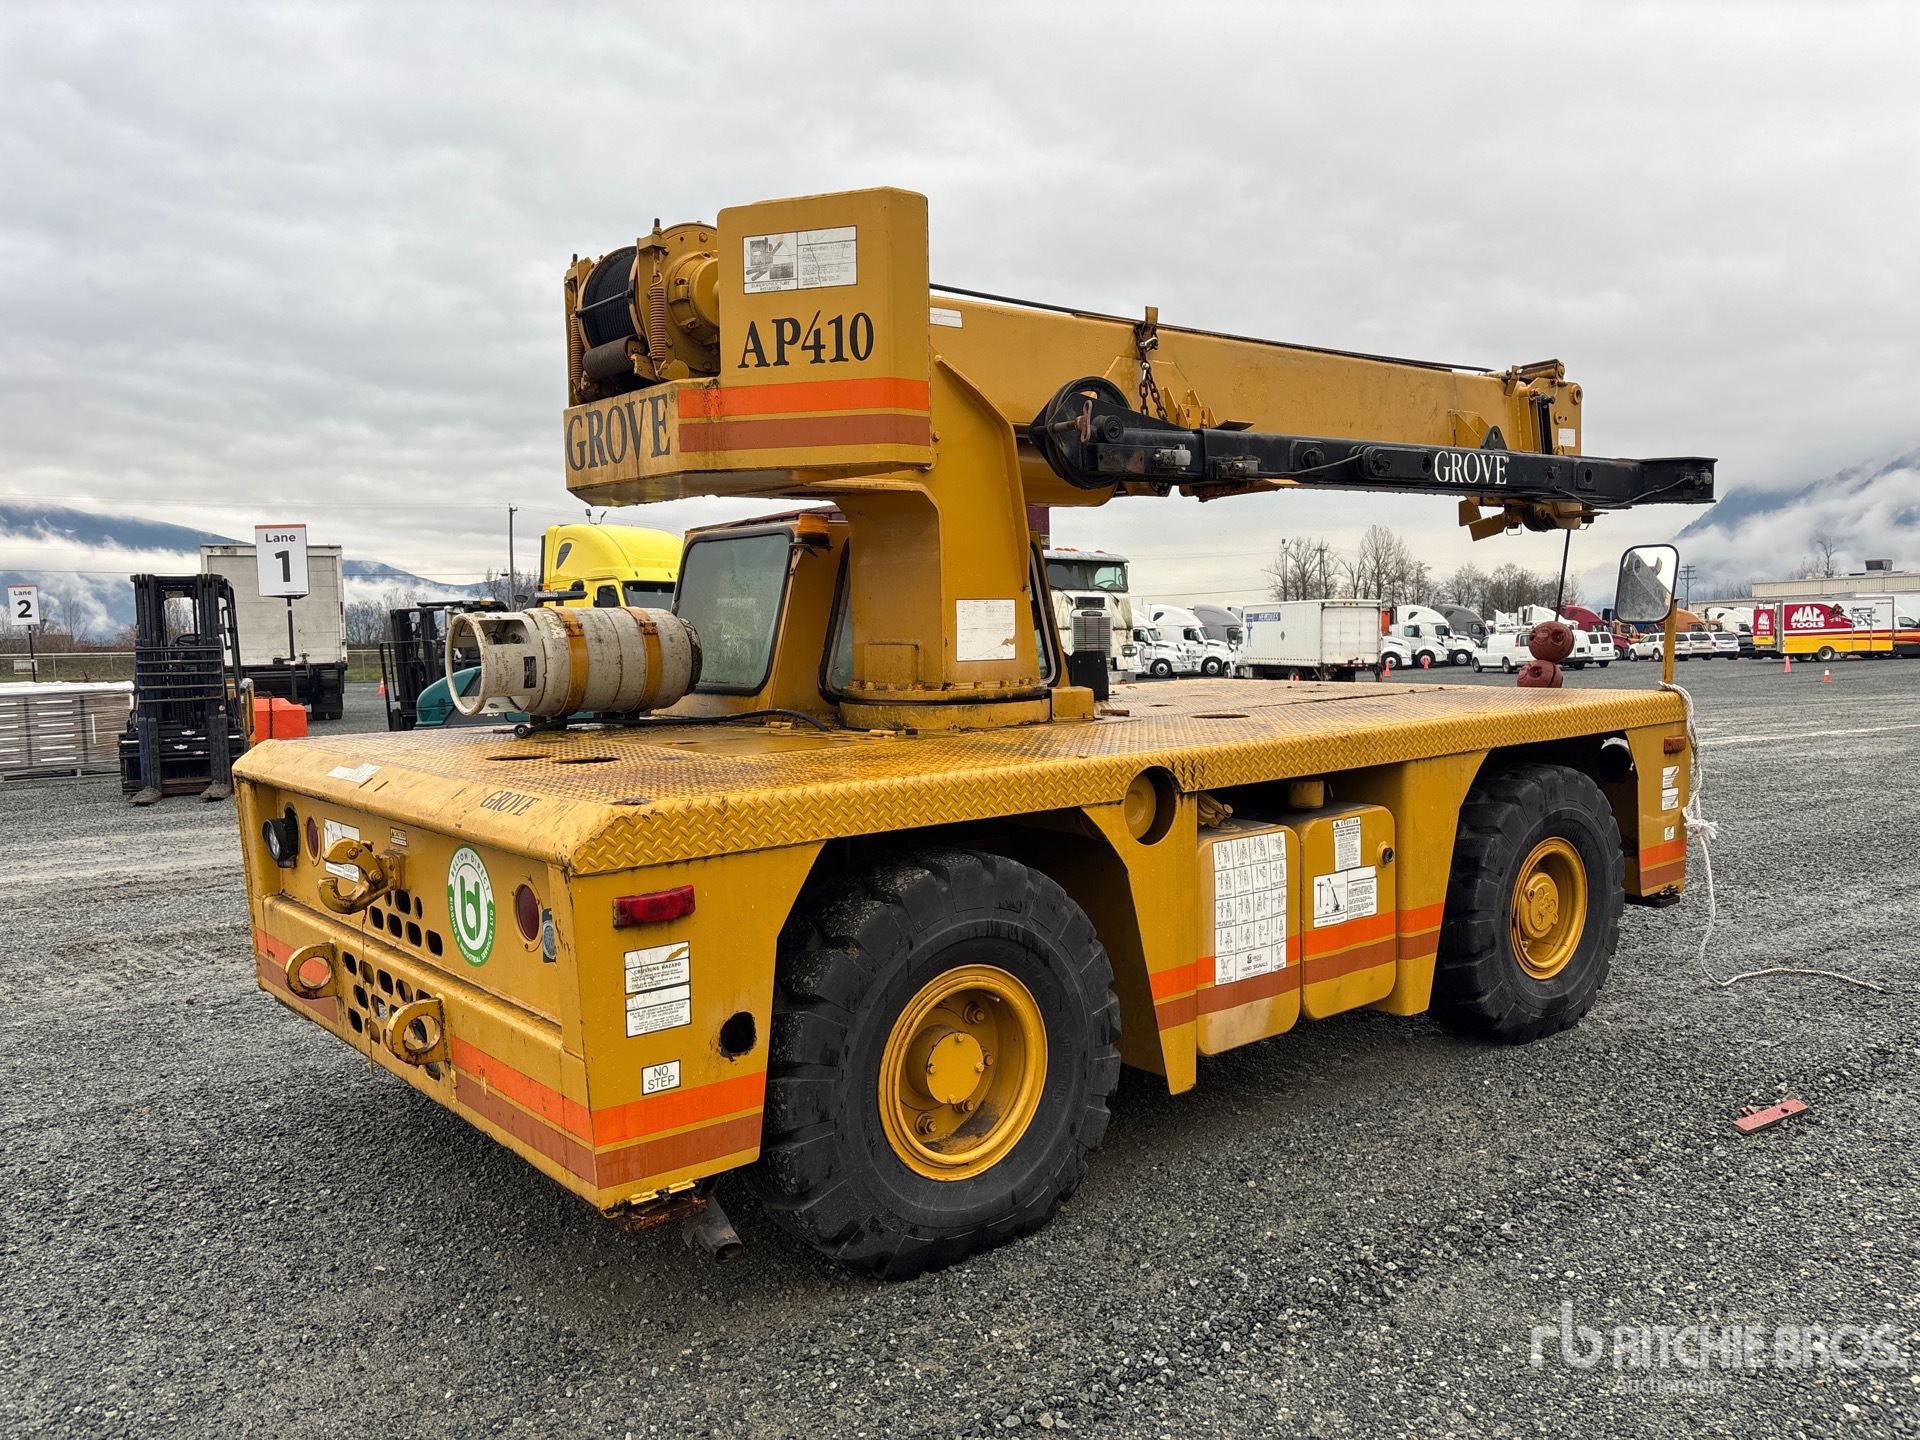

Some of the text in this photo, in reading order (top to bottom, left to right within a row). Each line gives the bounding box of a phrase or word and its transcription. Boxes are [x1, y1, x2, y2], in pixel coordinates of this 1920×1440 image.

[737, 310, 874, 369] AP410
[566, 393, 671, 472] GROVE
[1434, 450, 1507, 485] GROVE
[265, 533, 296, 543] Lane
[274, 550, 291, 583] 1
[17, 599, 33, 618] 2
[1791, 606, 1825, 622] MAC
[479, 790, 541, 817] GROVE
[470, 853, 491, 892] DIRECT
[647, 1074, 675, 1090] STEP
[653, 1065, 669, 1078] NO
